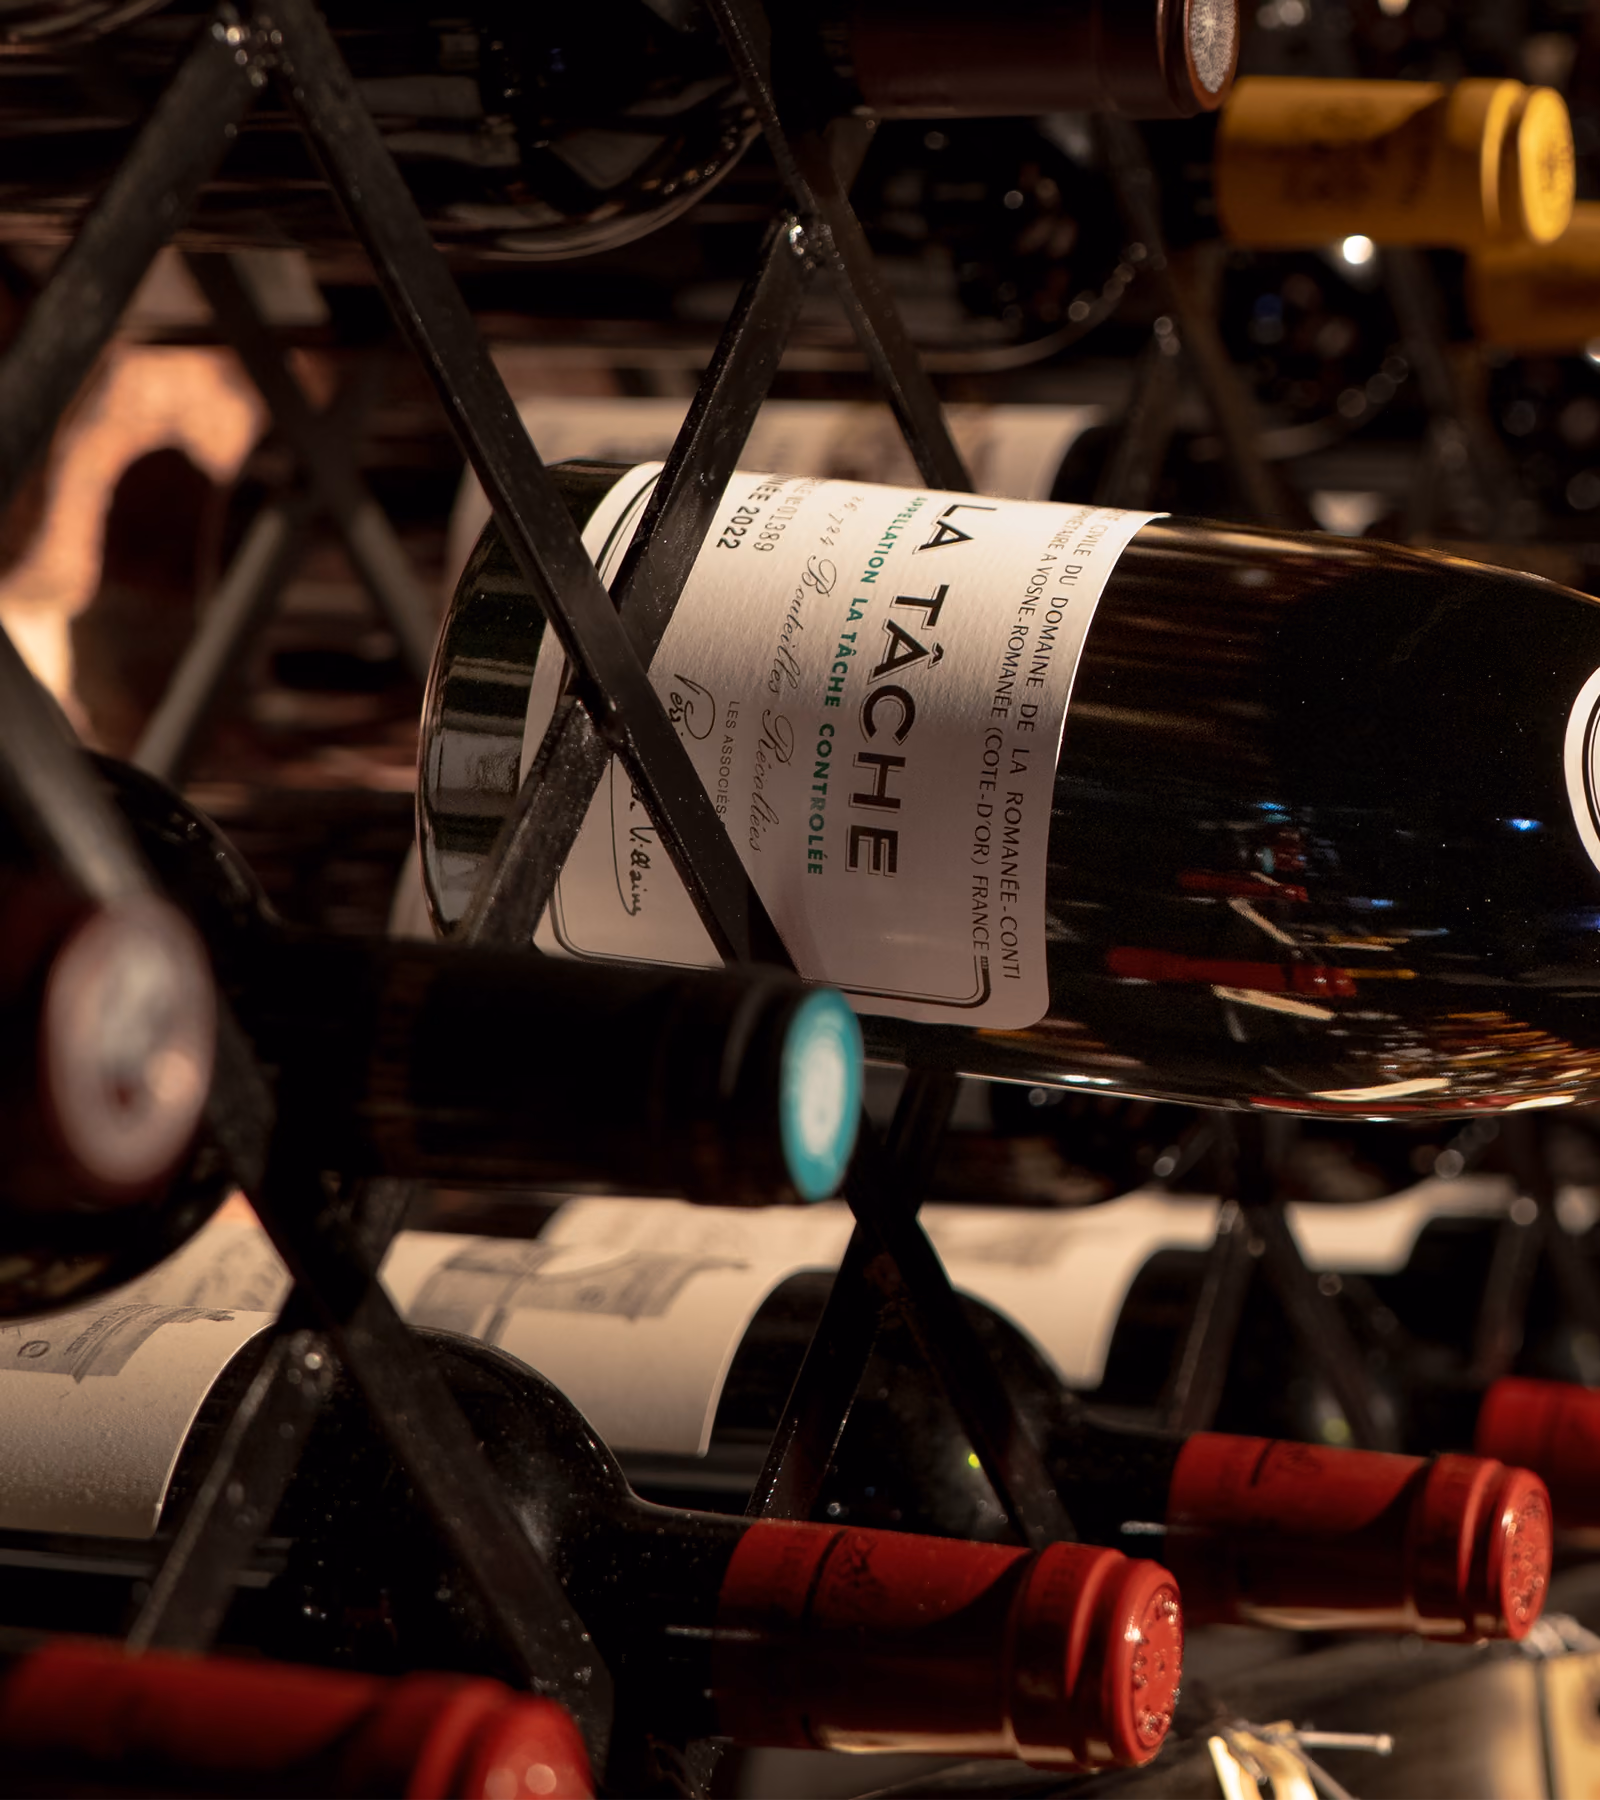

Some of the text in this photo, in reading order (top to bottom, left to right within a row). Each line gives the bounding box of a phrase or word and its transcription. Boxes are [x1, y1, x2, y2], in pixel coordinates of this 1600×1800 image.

[716, 506, 760, 549] 2022
[1040, 552, 1058, 561] A
[768, 555, 838, 693] Bouteilles
[807, 496, 928, 874] APPELLATION LA TÂCHE CONTROLÉE
[845, 504, 997, 878] LA TÂCHE
[990, 567, 1048, 719] VOSNE-ROMANÉE
[725, 701, 741, 729] LES
[749, 709, 795, 852] Récoltées
[999, 524, 1108, 979] CIVILE DU DOMAINE DE LA ROMANÉE-CONTI
[971, 875, 990, 951] FRANCE
